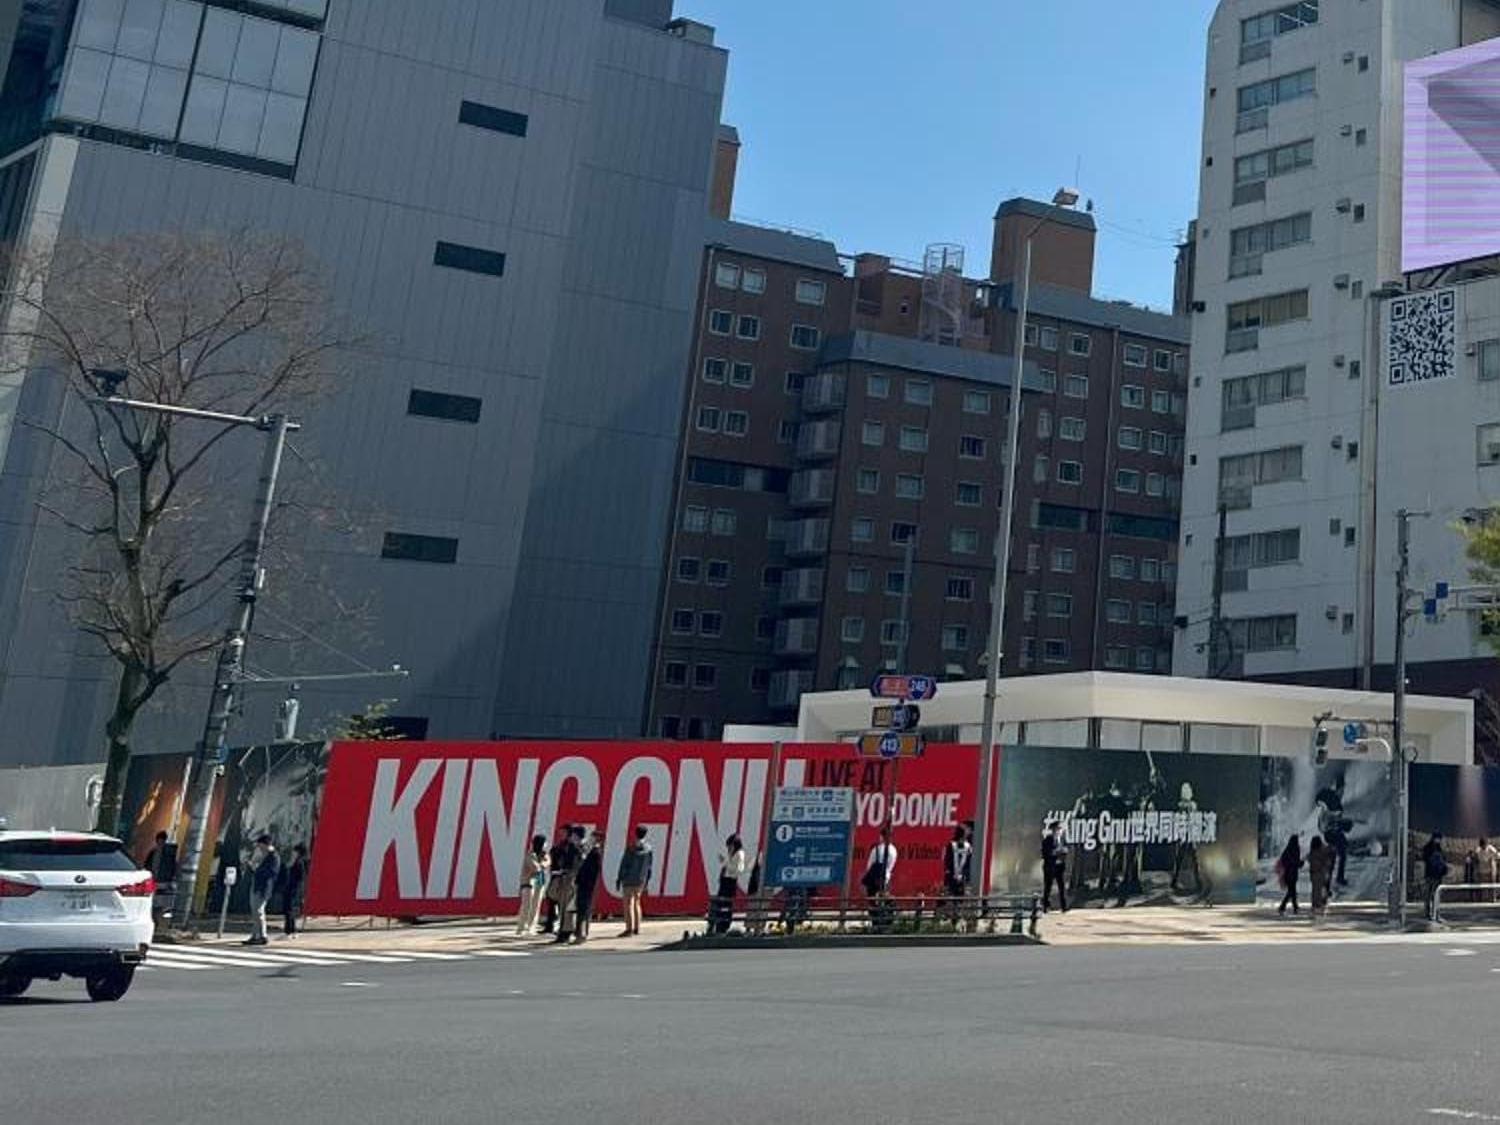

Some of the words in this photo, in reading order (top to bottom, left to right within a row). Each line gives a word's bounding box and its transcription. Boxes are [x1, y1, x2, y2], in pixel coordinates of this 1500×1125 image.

[806, 759, 857, 787] LIVE
[862, 760, 887, 791] AT
[892, 792, 961, 826] DOME
